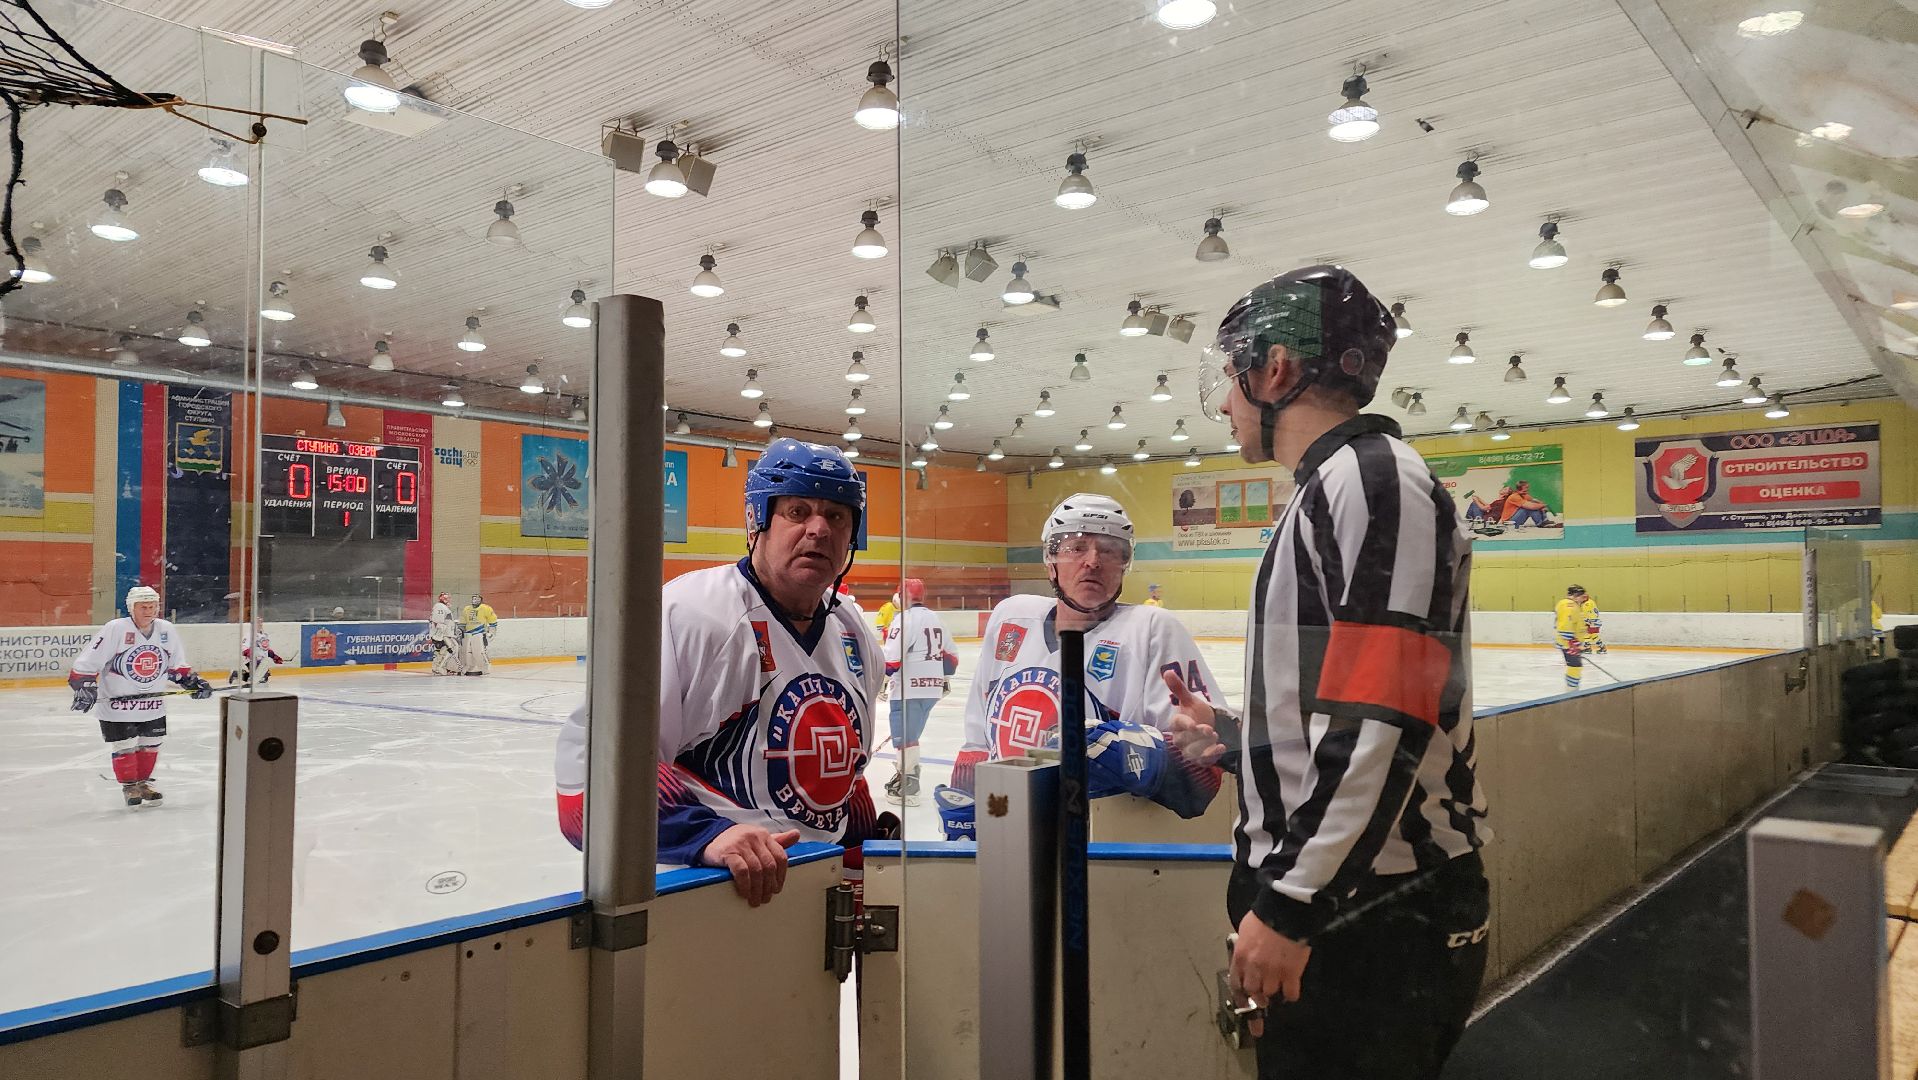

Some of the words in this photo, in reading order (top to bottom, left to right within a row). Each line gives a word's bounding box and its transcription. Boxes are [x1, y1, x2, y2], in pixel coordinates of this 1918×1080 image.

[296, 439, 339, 453] СТУПИНО
[1730, 433, 1775, 449] ООО
[439, 457, 463, 468] 2014
[1725, 456, 1865, 474] СТРОИТЕЛЬСТВО
[326, 466, 359, 475] ВРЕМЯ
[289, 463, 310, 499] 0
[397, 472, 416, 505] 0
[1759, 485, 1827, 499] ОЦЕНКА
[264, 499, 312, 508] УДАЛЕНИЯ
[323, 501, 364, 511] ПЕРИОД
[375, 504, 417, 513] УДАЛЕНИЯ
[347, 634, 414, 643] ГУБЕРНАТОРСКАЯ
